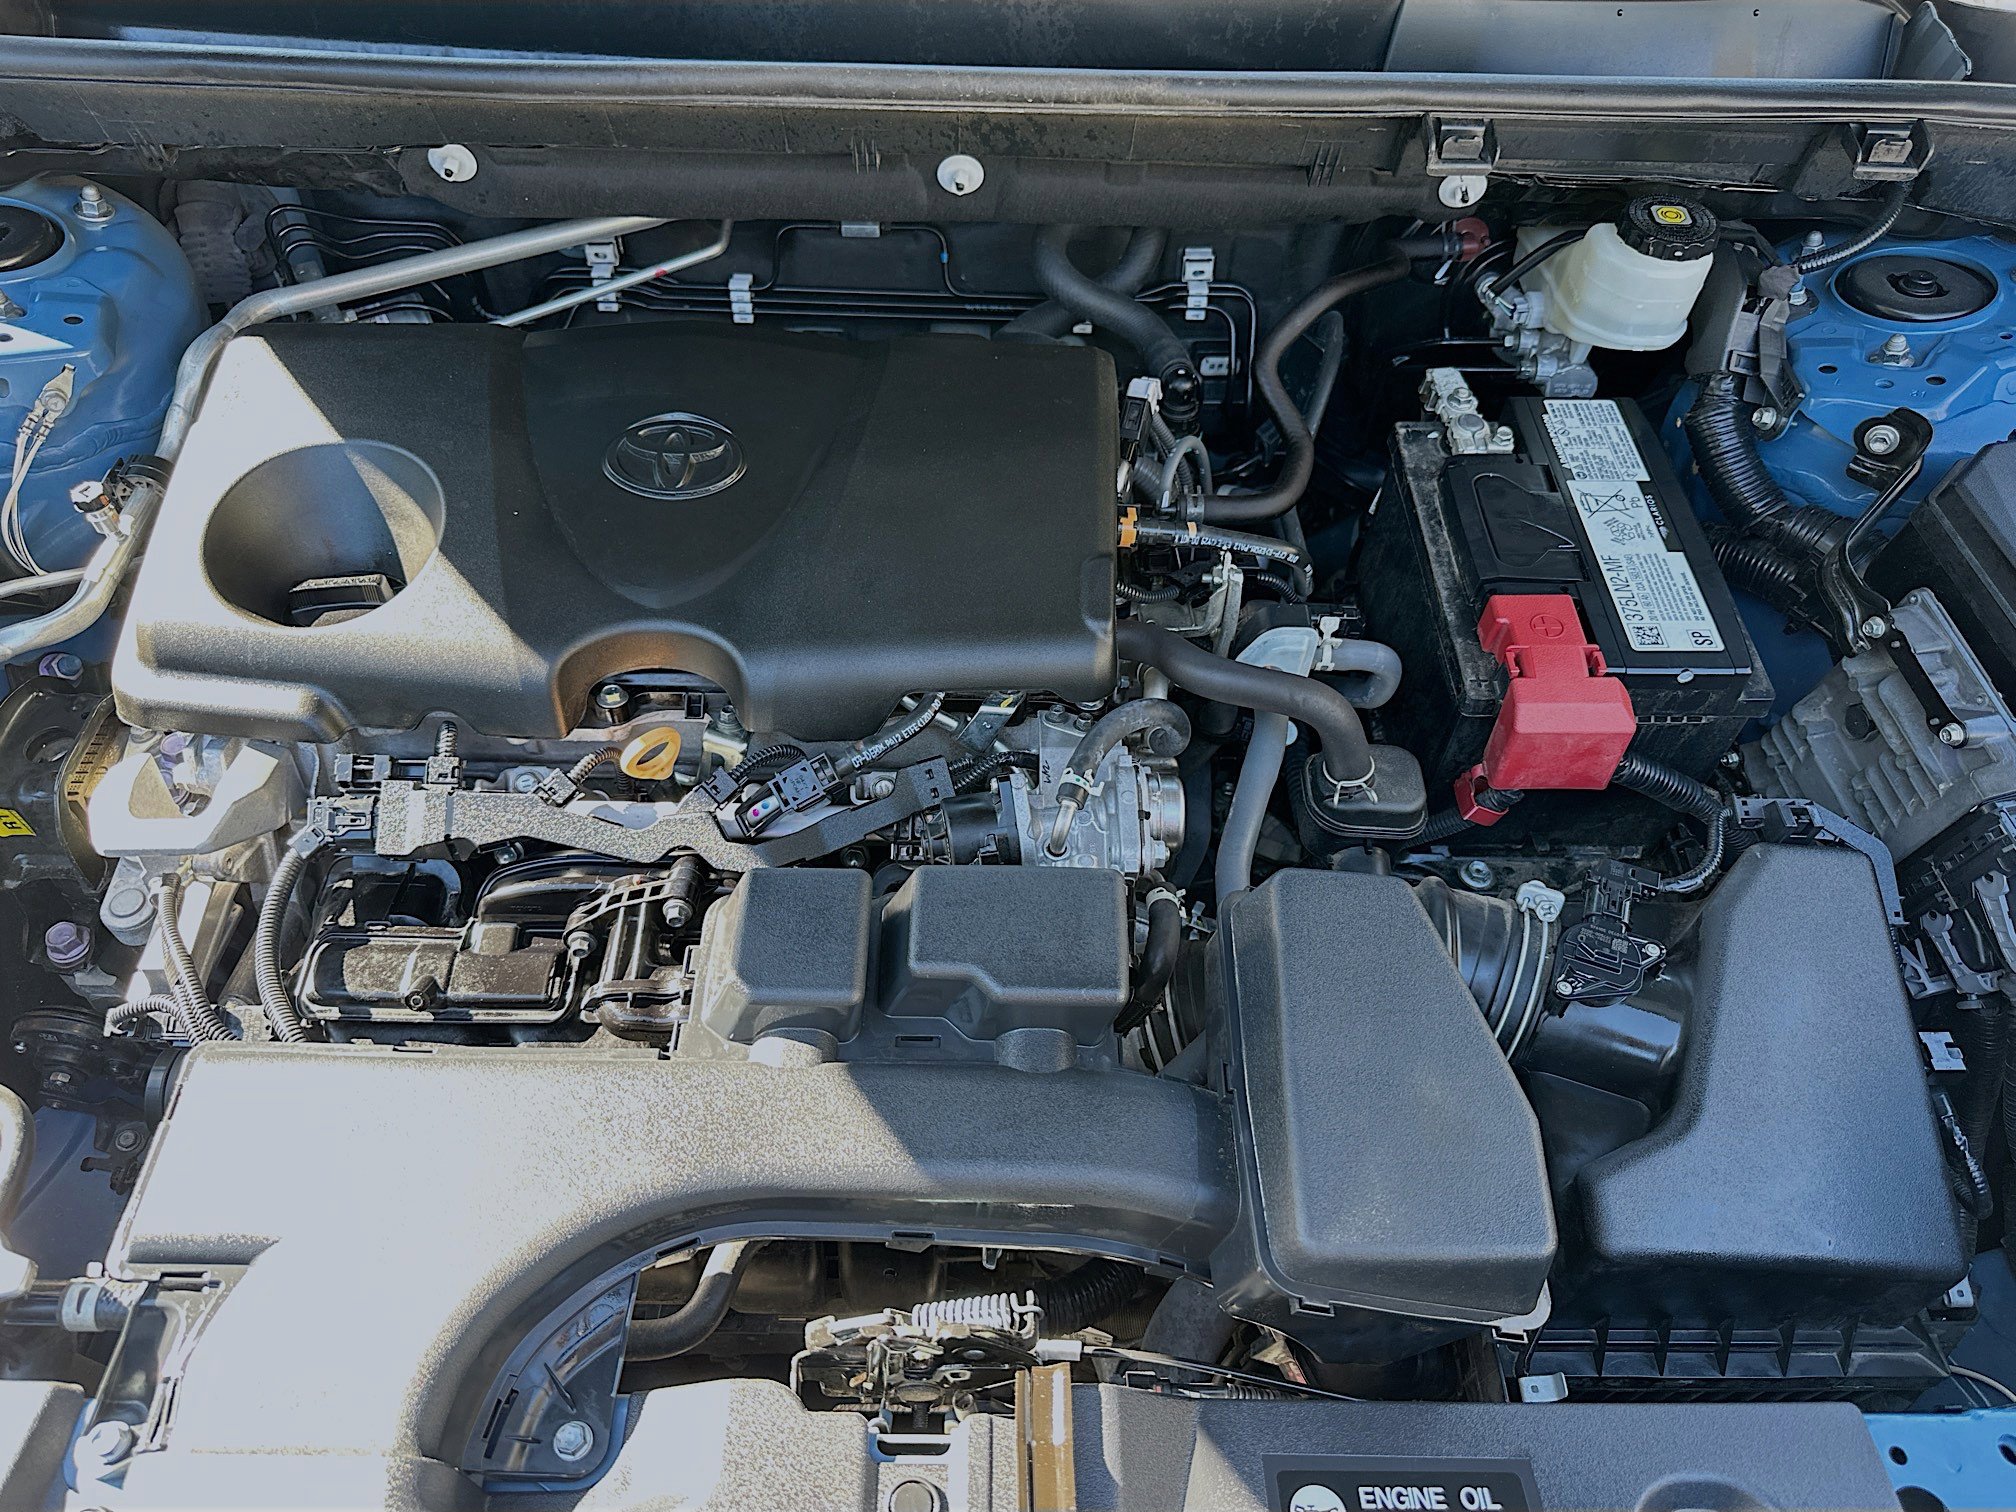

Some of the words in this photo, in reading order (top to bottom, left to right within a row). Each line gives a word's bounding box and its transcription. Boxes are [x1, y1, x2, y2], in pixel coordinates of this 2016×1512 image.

[1627, 496, 1643, 508] Pb
[1644, 494, 1665, 525] CLARIOS
[1600, 554, 1644, 620] 375LN2-MF
[1633, 582, 1645, 591] CCA
[1690, 630, 1713, 646] SP
[1358, 1485, 1450, 1511] ENGINE
[1459, 1485, 1503, 1511] OIL
